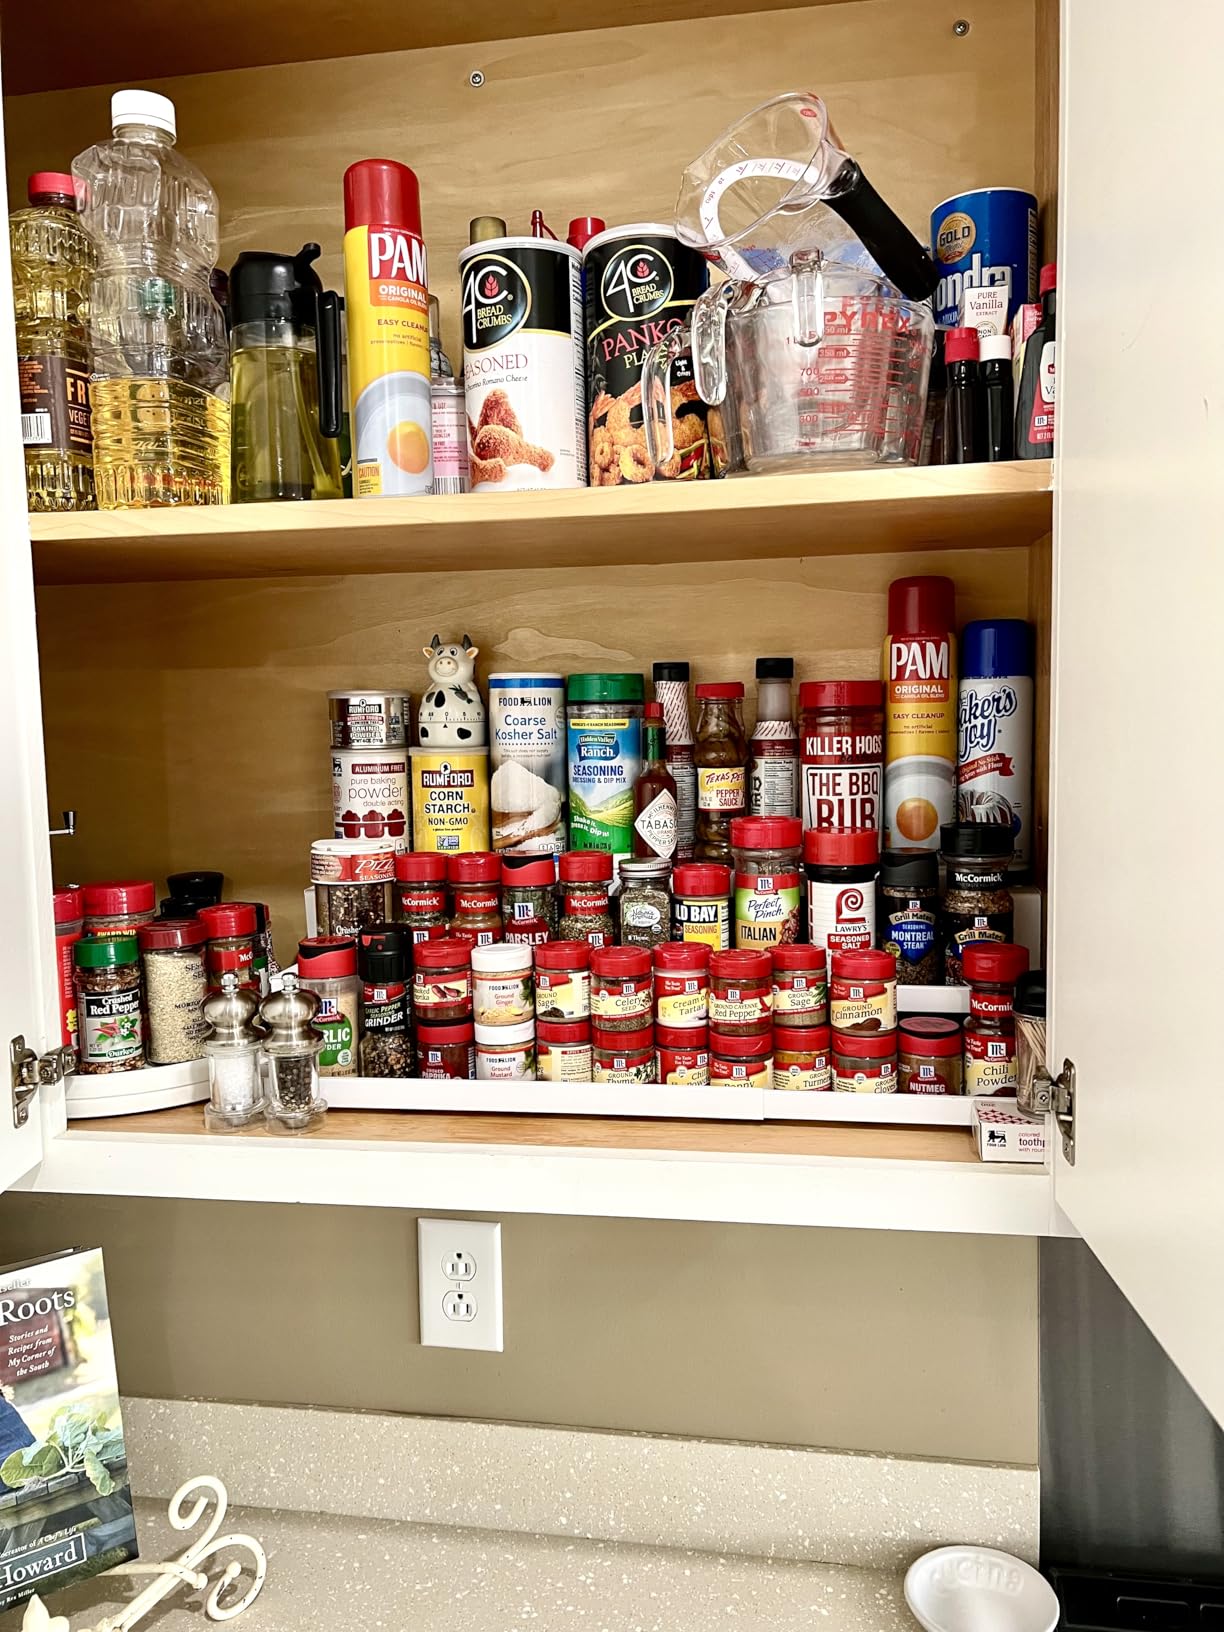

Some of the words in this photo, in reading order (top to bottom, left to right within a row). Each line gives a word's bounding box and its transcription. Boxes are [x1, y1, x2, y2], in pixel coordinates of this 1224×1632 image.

[940, 226, 970, 247] GOLD
[370, 233, 428, 288] PAM
[606, 254, 657, 313] 4C
[936, 252, 1012, 312] ondra
[379, 285, 427, 303] ORIGINAL
[632, 283, 657, 297] BREAD
[633, 290, 665, 304] CRUMBS
[970, 300, 1003, 310] Vanilla
[477, 305, 504, 319] BREAD
[477, 314, 513, 329] CRUMBS
[824, 311, 911, 334] PYREX
[624, 350, 649, 368] PLA
[464, 354, 528, 380] EASONED
[482, 376, 504, 386] Romano
[505, 374, 528, 382] Cheese
[891, 642, 948, 680] PAM
[895, 685, 943, 694] ORIGINAL
[499, 698, 518, 706] FOOD
[960, 688, 1013, 723] aker's
[505, 715, 546, 725] Coarse
[496, 729, 533, 740] Kosher
[538, 728, 557, 739] Salt
[806, 737, 852, 755] KILLER
[856, 735, 881, 755] HOGS
[581, 746, 613, 757] Ranch
[391, 764, 403, 772] FREE
[574, 765, 623, 776] SEASONING
[351, 778, 368, 786] pure
[371, 777, 396, 786] baking
[423, 773, 471, 785] RUMFORD
[706, 773, 729, 784] TEXAS
[809, 773, 842, 796] THE
[849, 771, 878, 796] BBQ
[349, 785, 403, 801] powder
[430, 791, 463, 800] CORN
[716, 790, 739, 798] PEPPER
[425, 804, 469, 813] STARCH
[718, 798, 738, 807] SAUCE
[574, 815, 590, 825] Shake
[355, 859, 394, 874] PIZZ
[360, 873, 394, 881] SEASONIN
[955, 873, 1002, 882] McCormick
[748, 897, 781, 912] Perfect
[690, 906, 716, 921] BAY
[895, 913, 910, 921] Grill
[685, 925, 717, 934] SEASONING
[741, 926, 776, 941] ITALIAN
[892, 931, 934, 940] MONTREAL
[959, 931, 976, 940] Grill
[505, 932, 548, 945] PARSLEY
[102, 994, 132, 1005] Crushed
[538, 1000, 554, 1008] Sage
[616, 996, 641, 1007] Celery
[673, 998, 700, 1009] Cream
[790, 998, 811, 1008] Sage
[90, 1005, 110, 1015] Red
[112, 1001, 139, 1014] Pepper
[381, 1002, 401, 1012] PEPPER
[680, 1003, 704, 1016] Tartar
[842, 1004, 873, 1012] GROUND
[365, 1011, 403, 1027] GRINDER
[729, 1009, 756, 1020] Pepper
[836, 1007, 882, 1020] Cinnamon
[983, 1064, 1009, 1076] Chili
[910, 1082, 945, 1092] NUTMEG
[0, 1290, 75, 1327] Roots
[9, 1331, 34, 1342] Stories
[35, 1325, 48, 1335] and
[8, 1343, 34, 1356] Recipes
[34, 1337, 52, 1350] from
[8, 1358, 20, 1367] My
[22, 1351, 47, 1363] Corner
[48, 1346, 56, 1356] of
[17, 1367, 27, 1376] the
[29, 1361, 49, 1373] South
